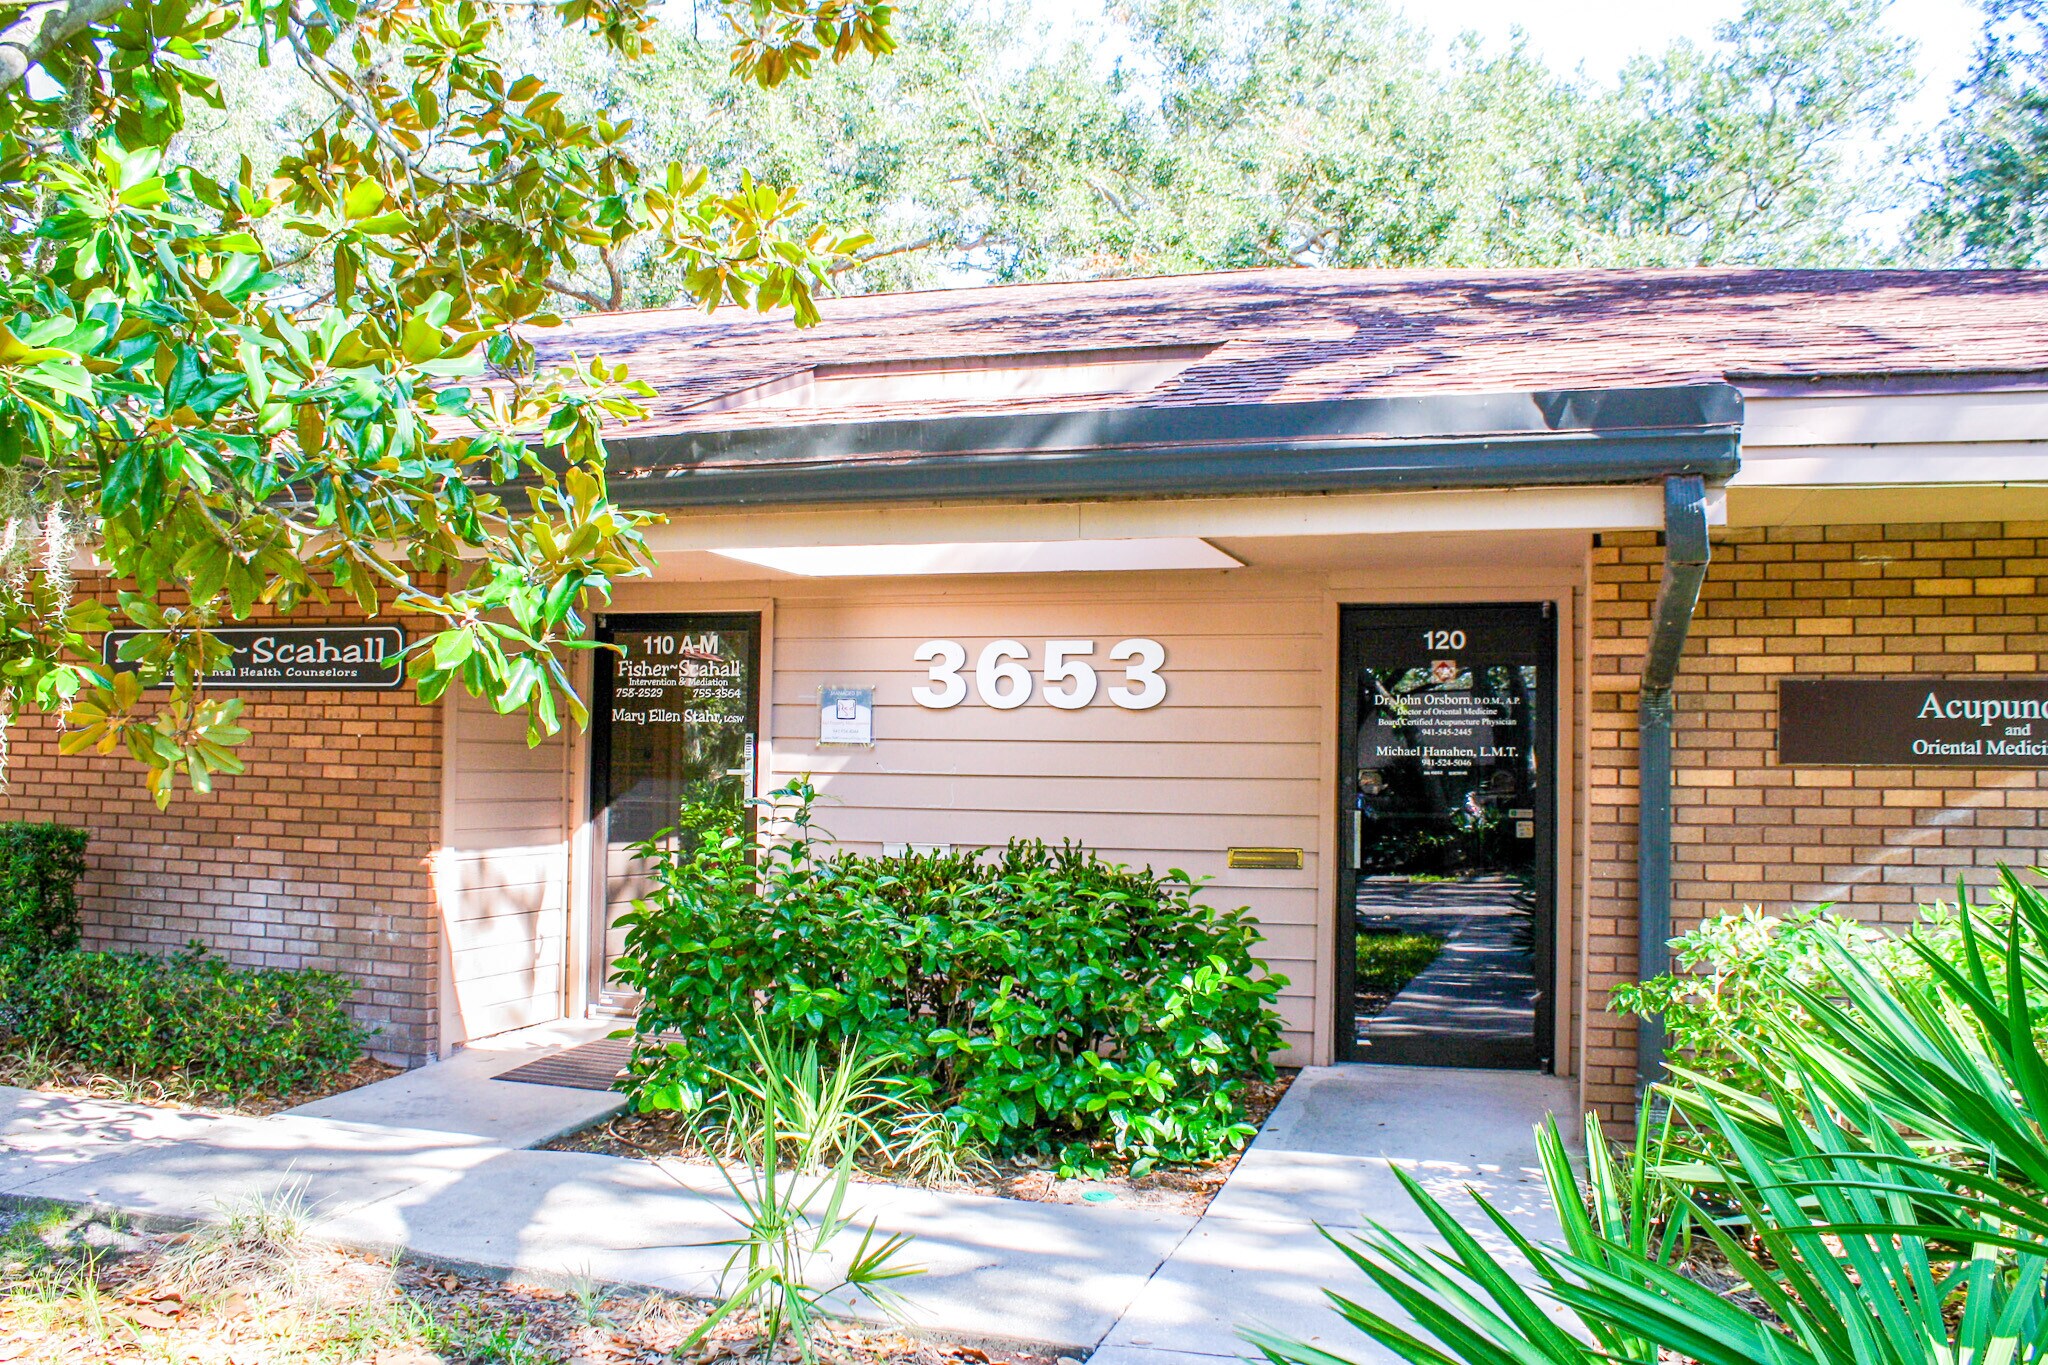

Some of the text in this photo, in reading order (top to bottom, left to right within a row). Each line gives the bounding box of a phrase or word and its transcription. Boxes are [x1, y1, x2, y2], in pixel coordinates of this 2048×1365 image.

[643, 635, 719, 655] 110 A-M
[1423, 630, 1467, 650] 120
[194, 668, 236, 678] Mntal
[240, 668, 282, 678] Health
[285, 667, 358, 678] Counselors
[618, 659, 741, 677] Fisher~Scahall
[912, 638, 1167, 710] 3653
[629, 677, 728, 687] Intervention & Mediation
[616, 687, 663, 698] 758-2529
[1374, 694, 1391, 706] Dr.
[1394, 694, 1422, 706] John
[612, 708, 745, 725] Mary Ellen Stahr, LCSW
[1397, 708, 1498, 716] Doctor of Oriental Medicine
[1378, 718, 1517, 728] Board Certified Acupuncture Physician
[2005, 723, 2031, 736] and
[1376, 745, 1519, 758] Michael Hanahen, L.M.T.
[1912, 739, 2048, 756] Oriental Medici
